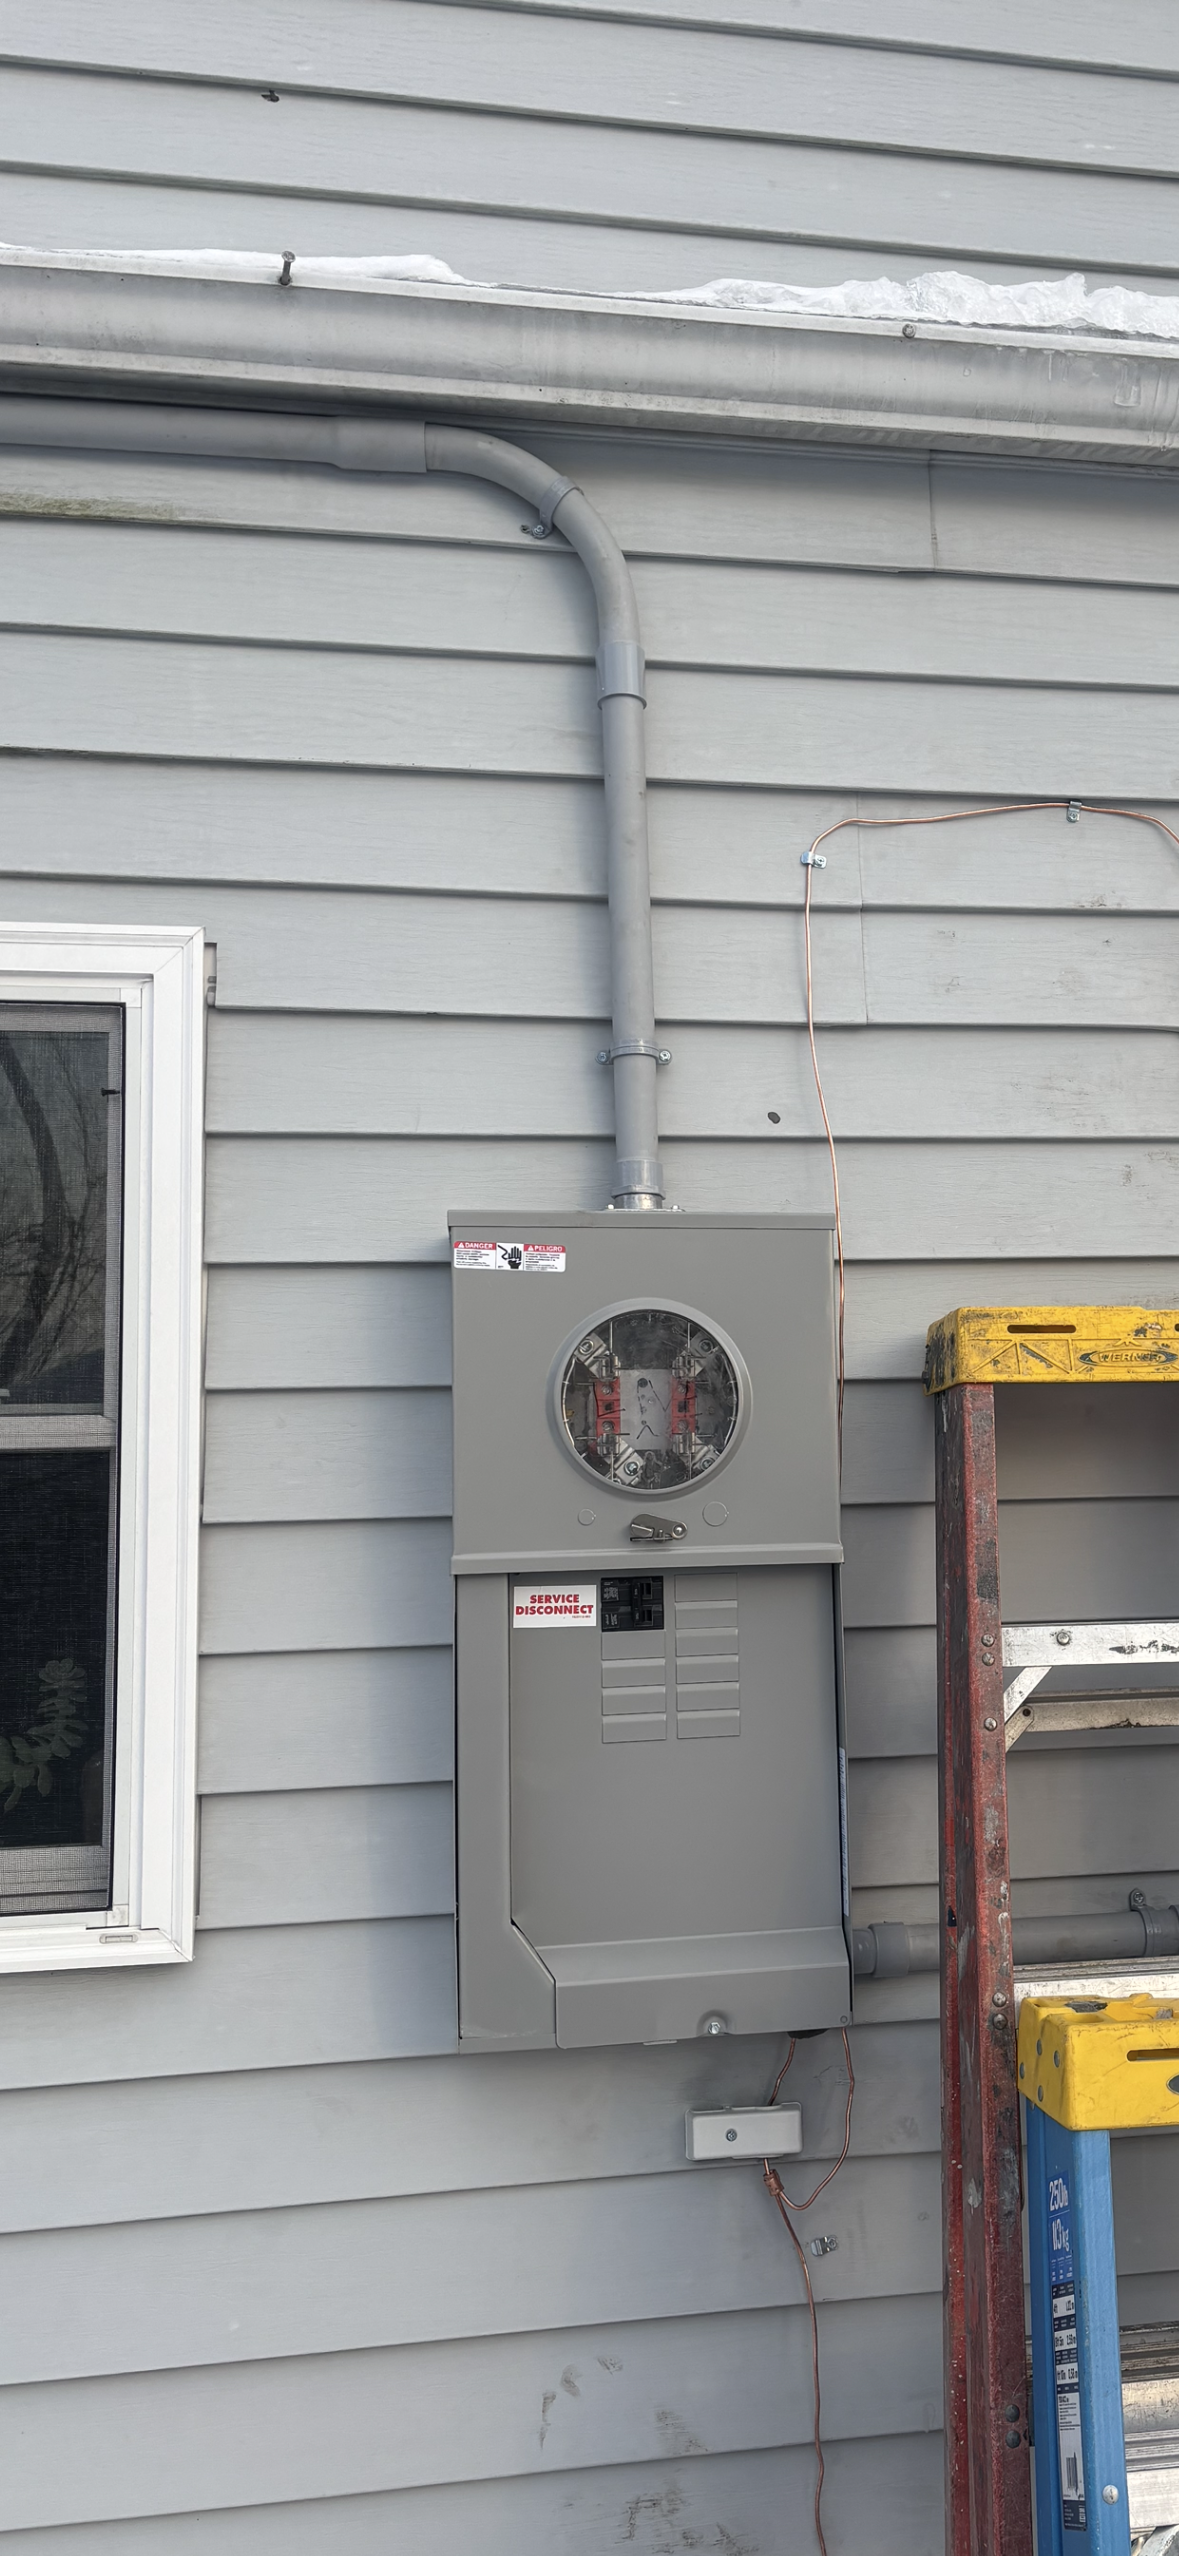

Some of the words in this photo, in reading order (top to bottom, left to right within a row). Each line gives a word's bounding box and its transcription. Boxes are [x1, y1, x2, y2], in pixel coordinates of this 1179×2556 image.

[1098, 1352, 1163, 1364] WERNER
[529, 1594, 580, 1604] SERVICE
[515, 1605, 594, 1616] DISCONNECT
